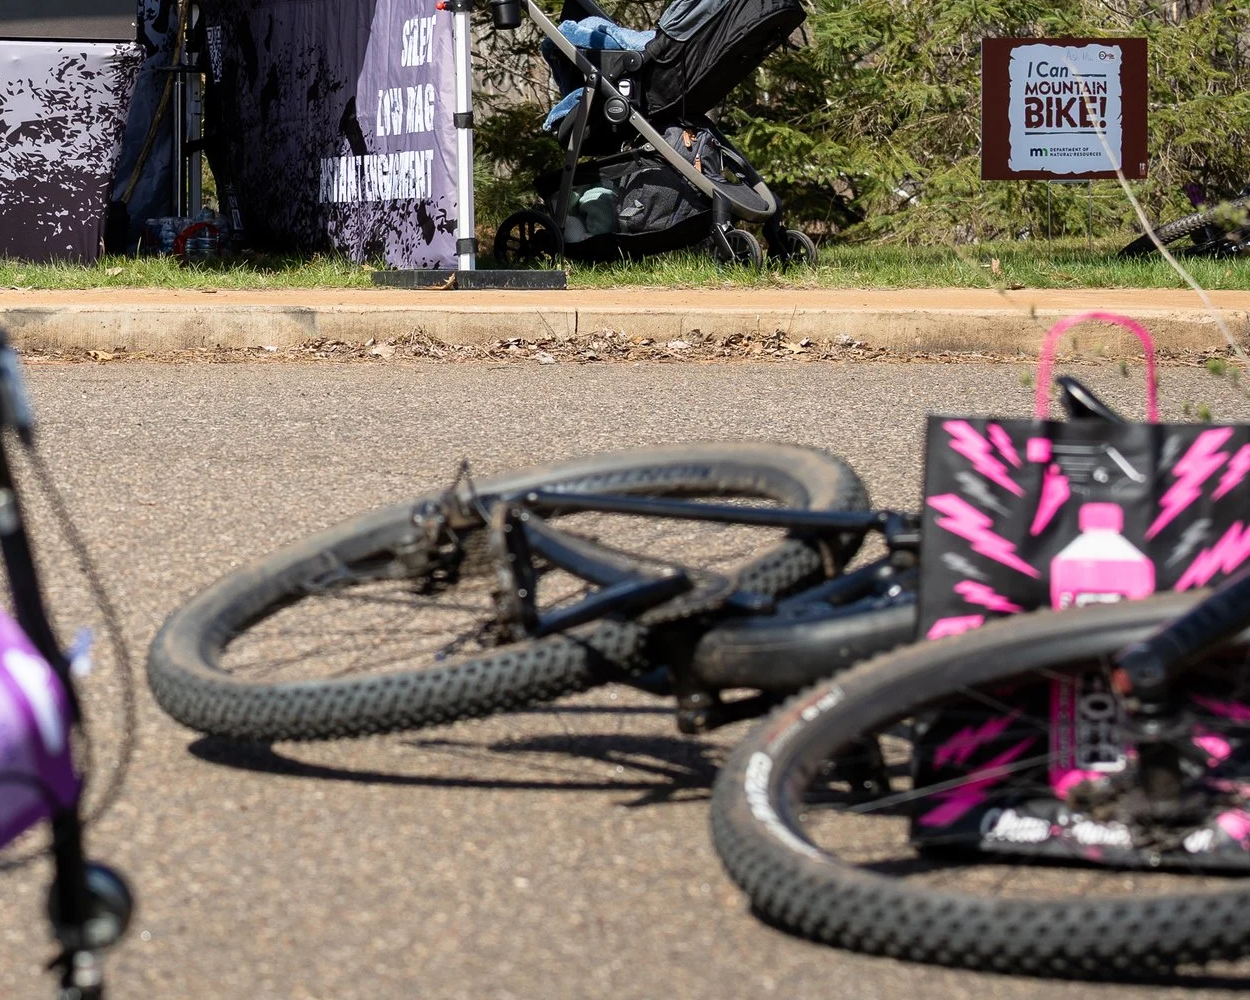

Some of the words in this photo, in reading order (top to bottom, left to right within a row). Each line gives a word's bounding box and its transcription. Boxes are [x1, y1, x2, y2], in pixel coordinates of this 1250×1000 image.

[1027, 61, 1033, 78] I
[1036, 61, 1069, 78] Can
[1024, 81, 1108, 96] MOUNTAIN
[1024, 96, 1108, 129] BIKE!
